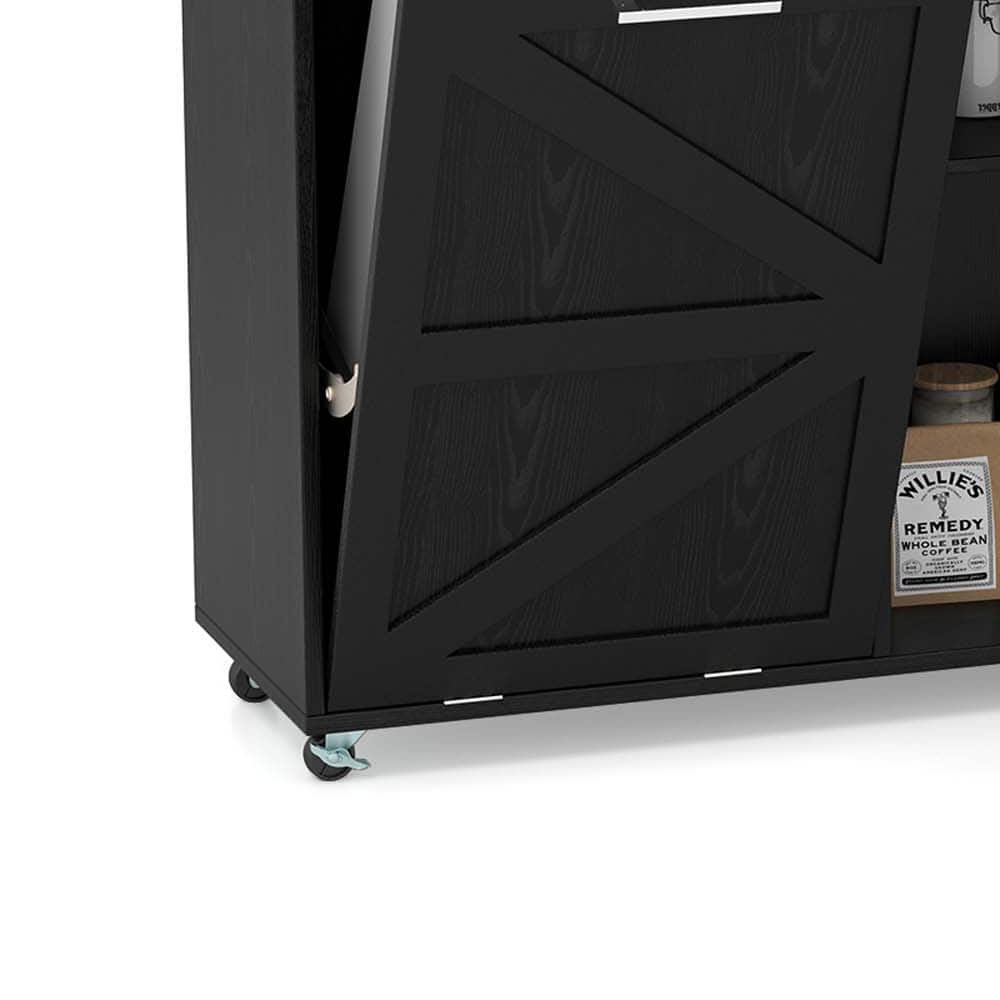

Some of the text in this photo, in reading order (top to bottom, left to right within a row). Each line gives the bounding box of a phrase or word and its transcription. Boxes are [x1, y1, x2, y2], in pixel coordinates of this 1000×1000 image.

[899, 471, 984, 499] WILLIE'S
[904, 519, 983, 535] REMEDY
[901, 541, 947, 551] WHOLE
[952, 535, 987, 546] BEAN
[922, 547, 967, 556] COFFEE
